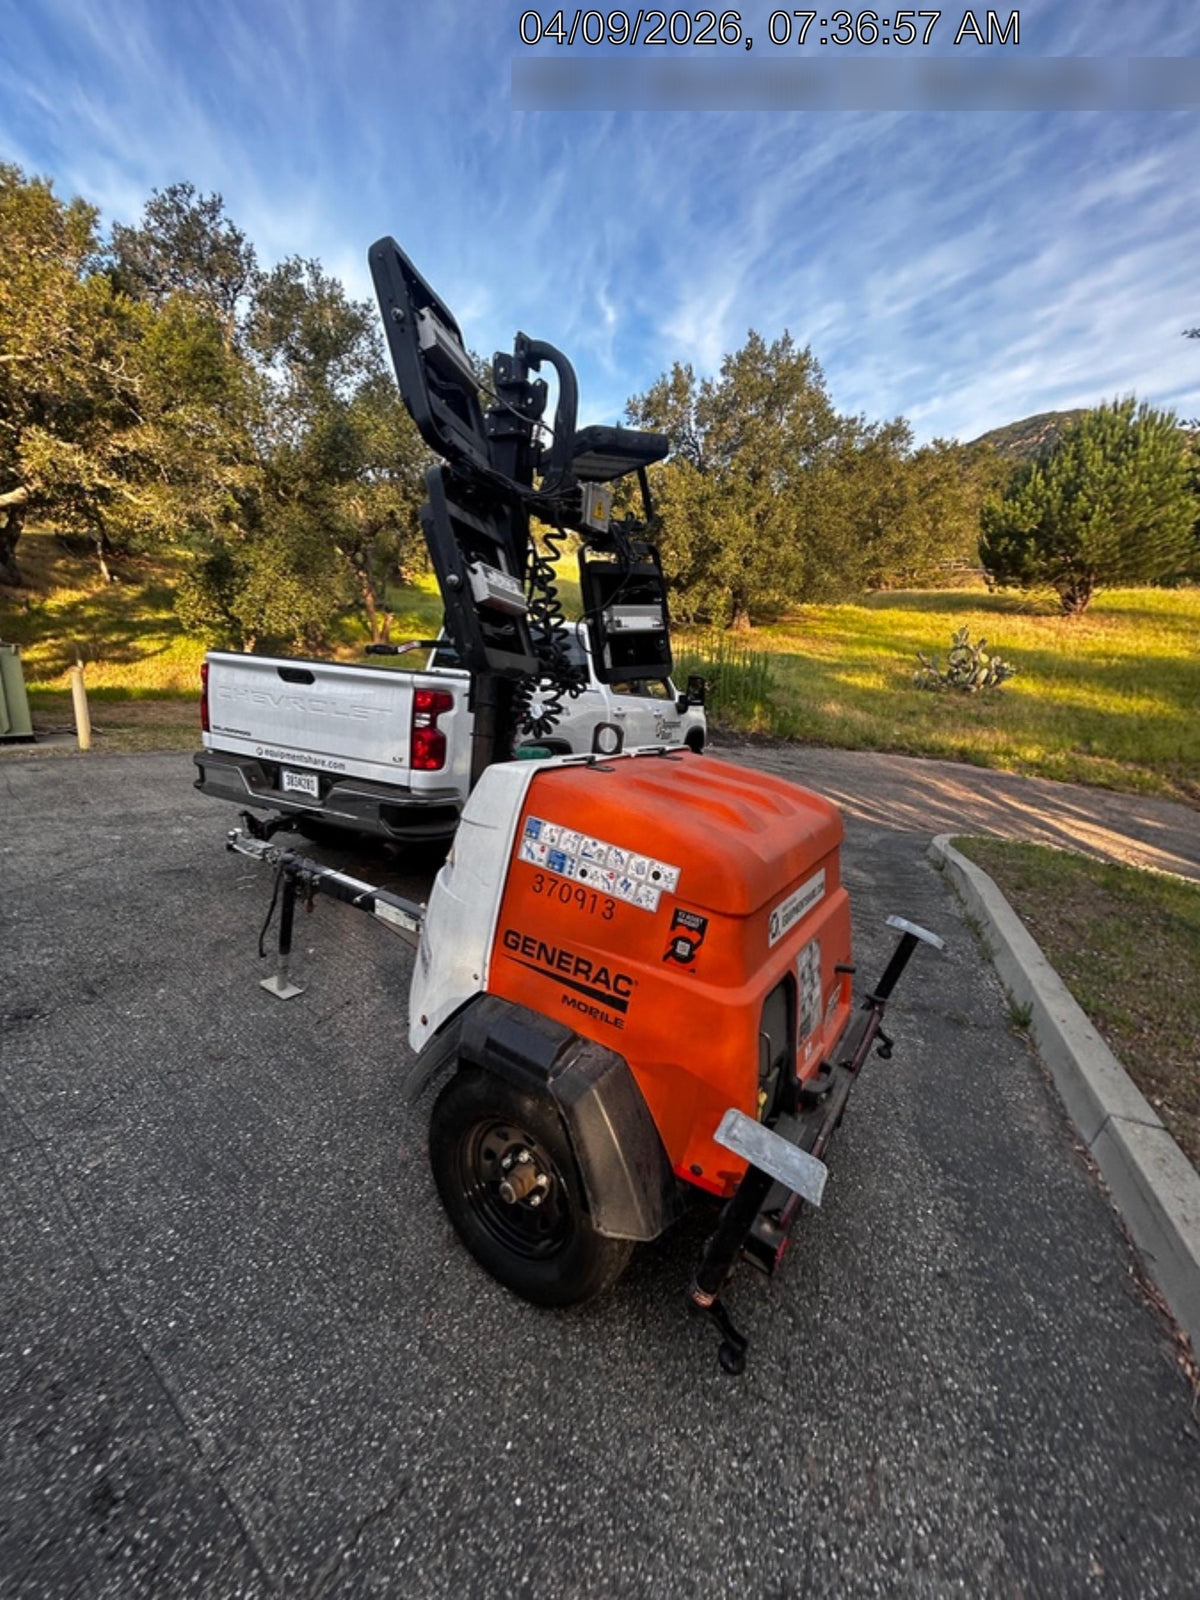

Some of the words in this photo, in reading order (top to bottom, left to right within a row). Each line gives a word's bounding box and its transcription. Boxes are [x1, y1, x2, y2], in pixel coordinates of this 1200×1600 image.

[217, 685, 393, 721] CHEVROLET
[264, 749, 346, 770] equipmentshare.com
[532, 873, 616, 920] 370913
[503, 929, 634, 998] GENERAC
